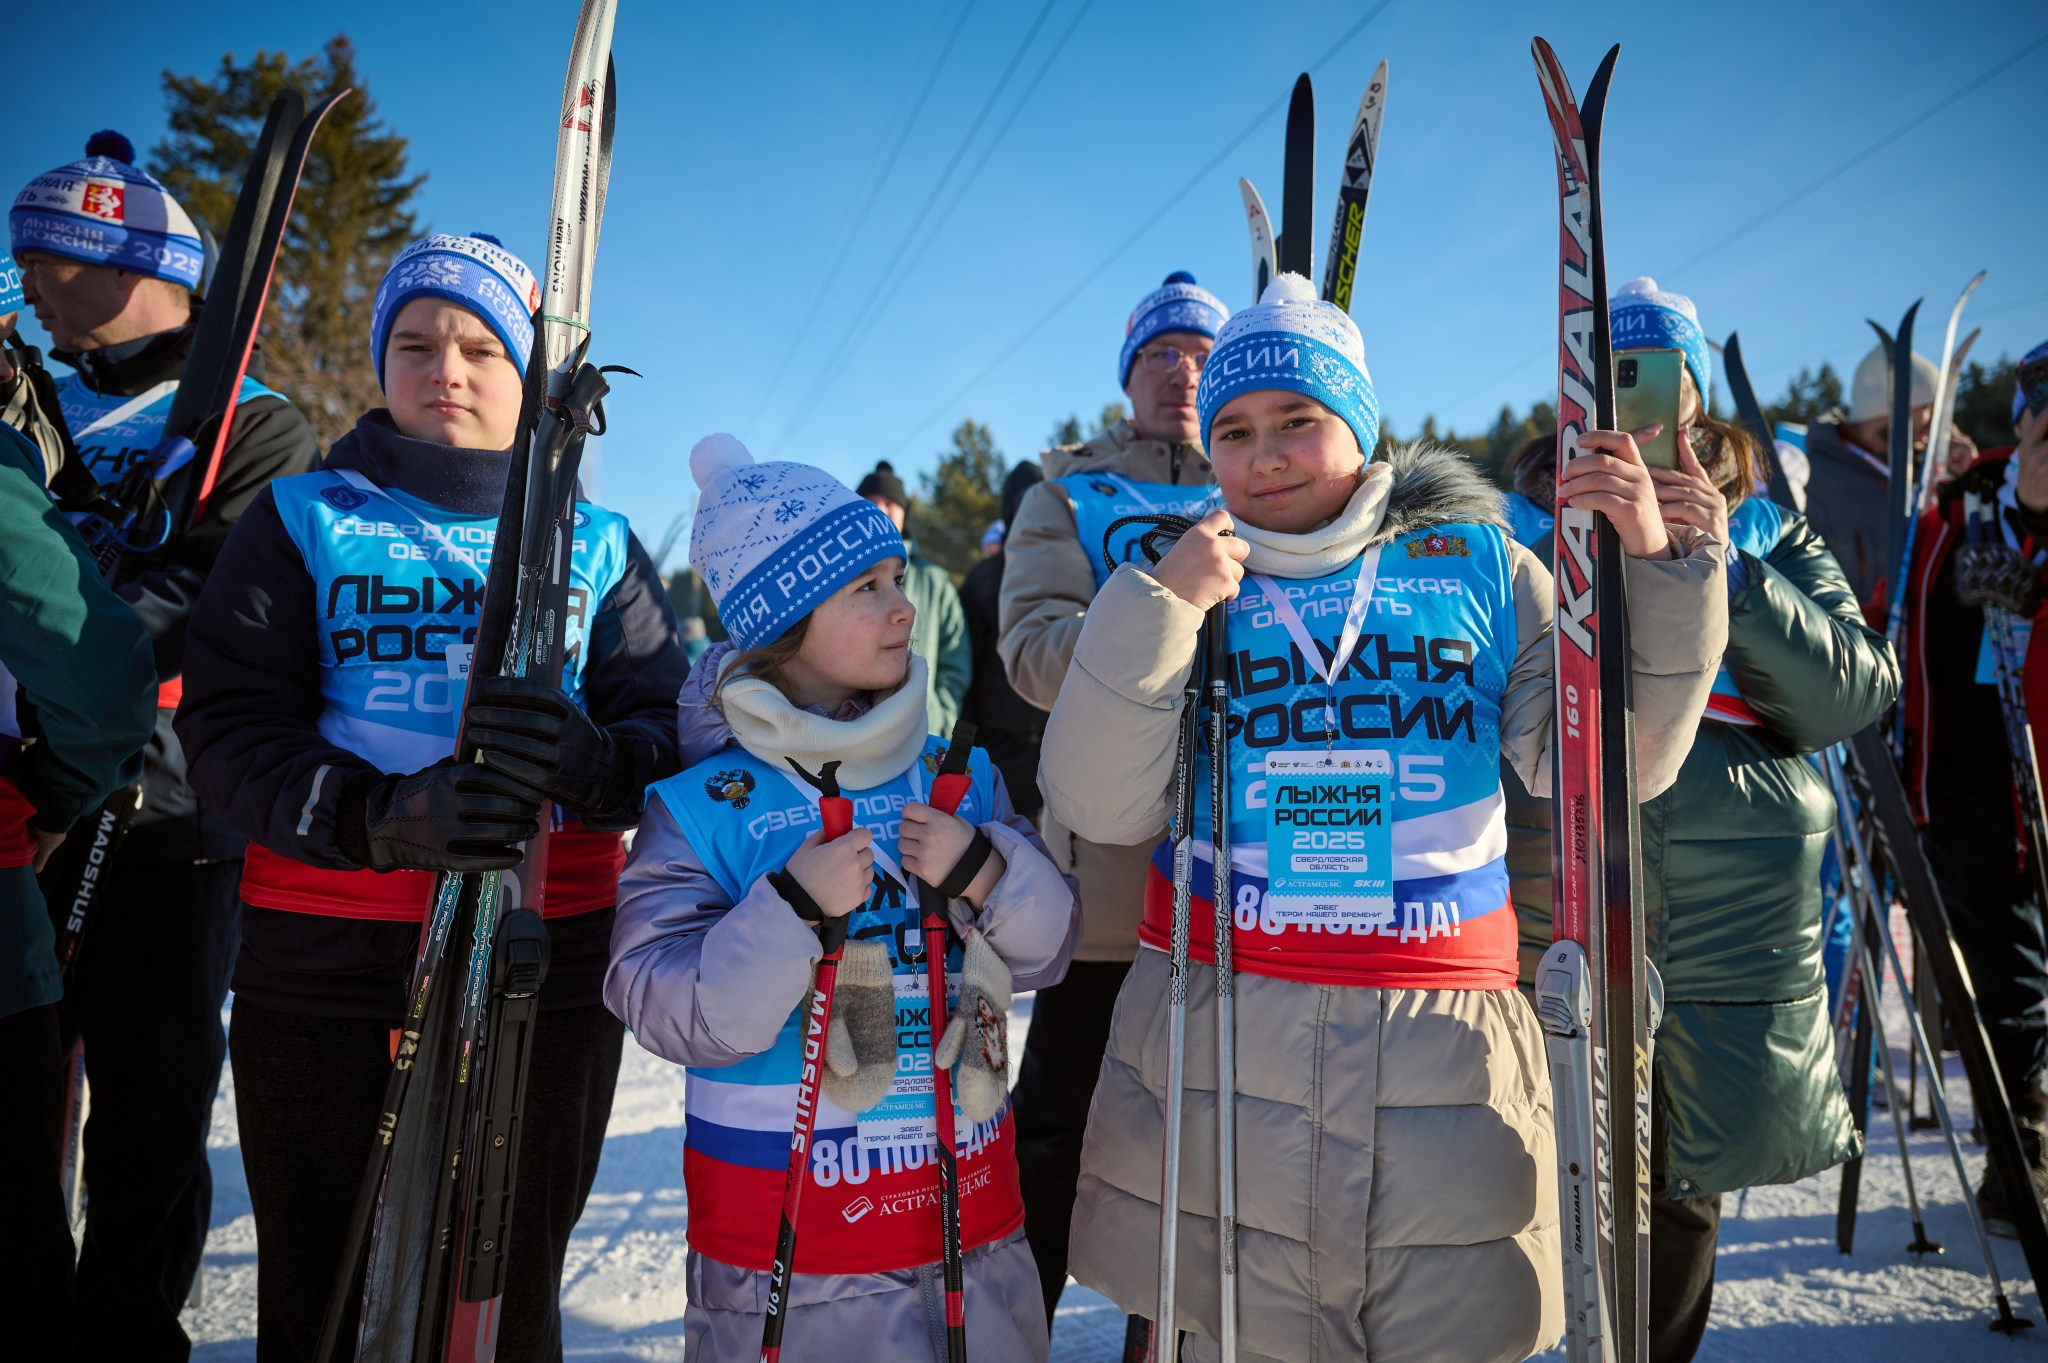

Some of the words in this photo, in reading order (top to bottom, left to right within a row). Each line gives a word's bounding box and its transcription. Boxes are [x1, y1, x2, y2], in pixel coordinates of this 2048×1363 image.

[23, 217, 104, 241] ЛЫЖНЯ
[22, 228, 103, 253] РОССИИ
[132, 241, 201, 277] 2025
[1334, 201, 1365, 315] ISCHER
[1199, 346, 1299, 405] ОССИИ
[728, 593, 771, 646] ЖНЯ
[776, 514, 897, 599] РОССИИ
[364, 670, 451, 713] 20
[1565, 684, 1580, 740] 160
[1275, 785, 1381, 805] ЛЫЖНЯ
[1275, 808, 1382, 826] РОССИИ
[1292, 831, 1366, 850] 2025
[66, 809, 116, 934] MADSHUS
[1287, 880, 1342, 888] АСТРАМЕД-МС
[478, 884, 494, 956] CROSSCOUNTRY
[475, 958, 483, 976] SKI
[470, 977, 481, 1008] POLES
[791, 988, 829, 1154] MADSHUS
[896, 1085, 934, 1093] ОБЛАСТЬ
[876, 1102, 927, 1112] АСТРАМЕД-МС
[893, 1133, 923, 1142] НАШЕГО
[900, 1125, 924, 1133] ЗАБЕГ
[1594, 1046, 1614, 1245] KARJALA
[1634, 1042, 1650, 1236] KARJALA
[812, 1136, 871, 1188] 80
[880, 1187, 920, 1201] СТРАХОВАЯ
[1572, 1184, 1583, 1245] KARJALA
